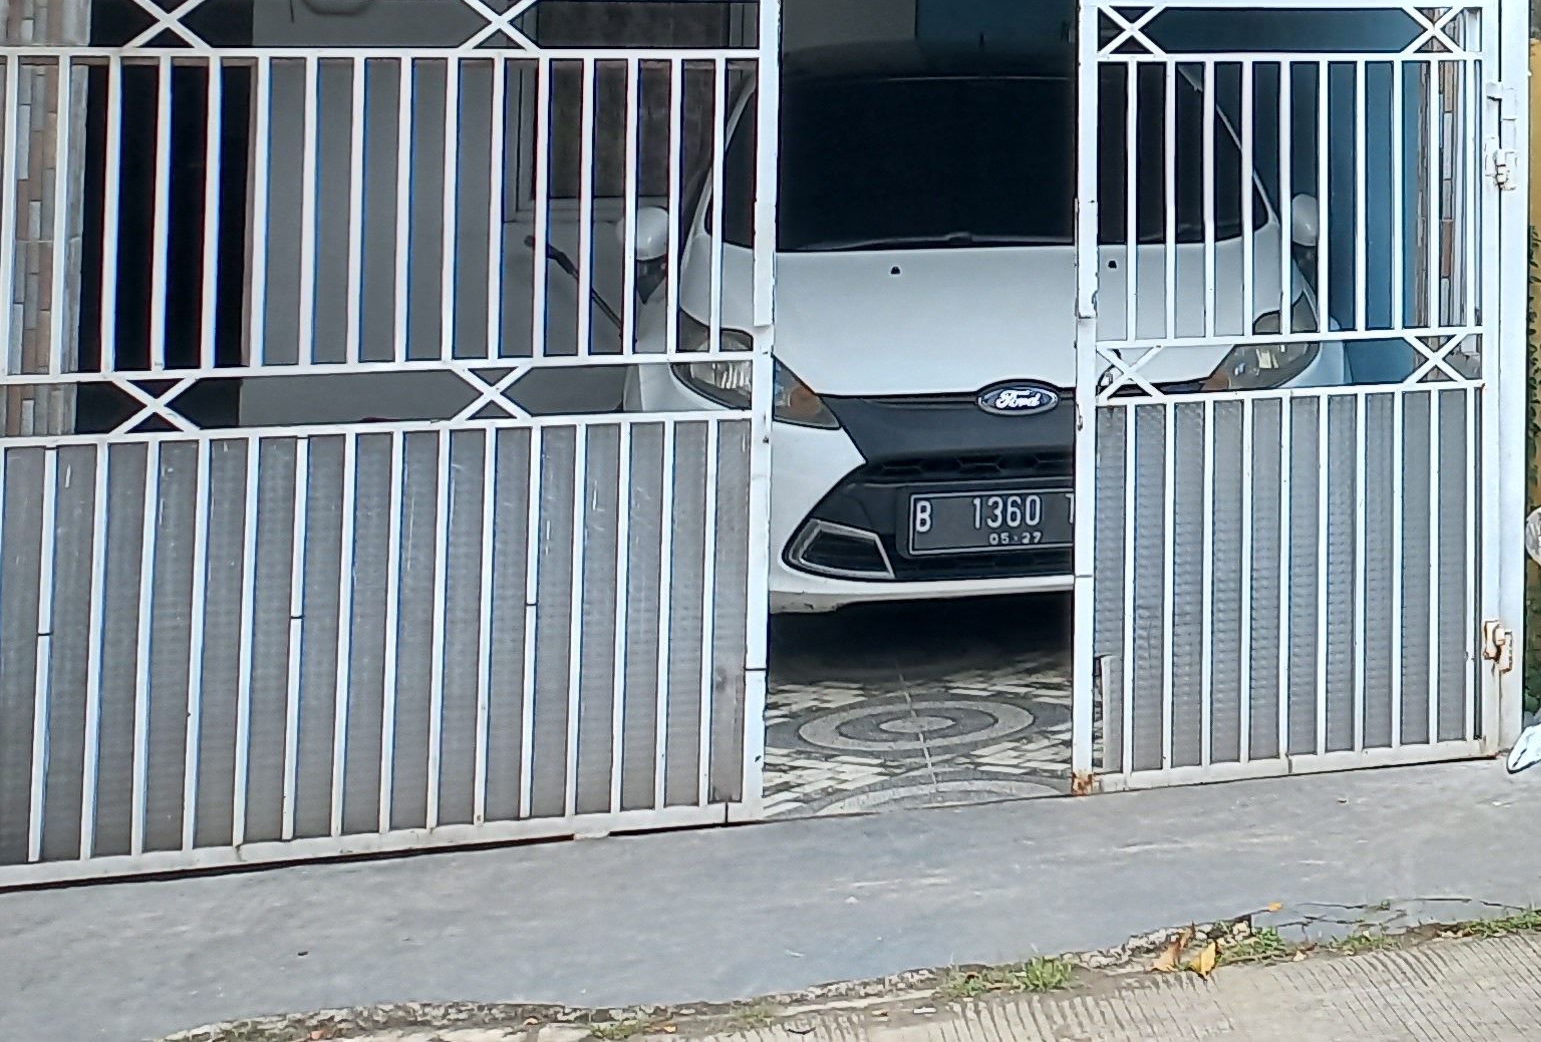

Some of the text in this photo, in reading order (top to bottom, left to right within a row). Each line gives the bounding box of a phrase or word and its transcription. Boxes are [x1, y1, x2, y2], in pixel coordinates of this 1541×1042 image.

[995, 389, 1042, 409] Ford
[915, 500, 933, 533] B
[972, 494, 1042, 530] 1360
